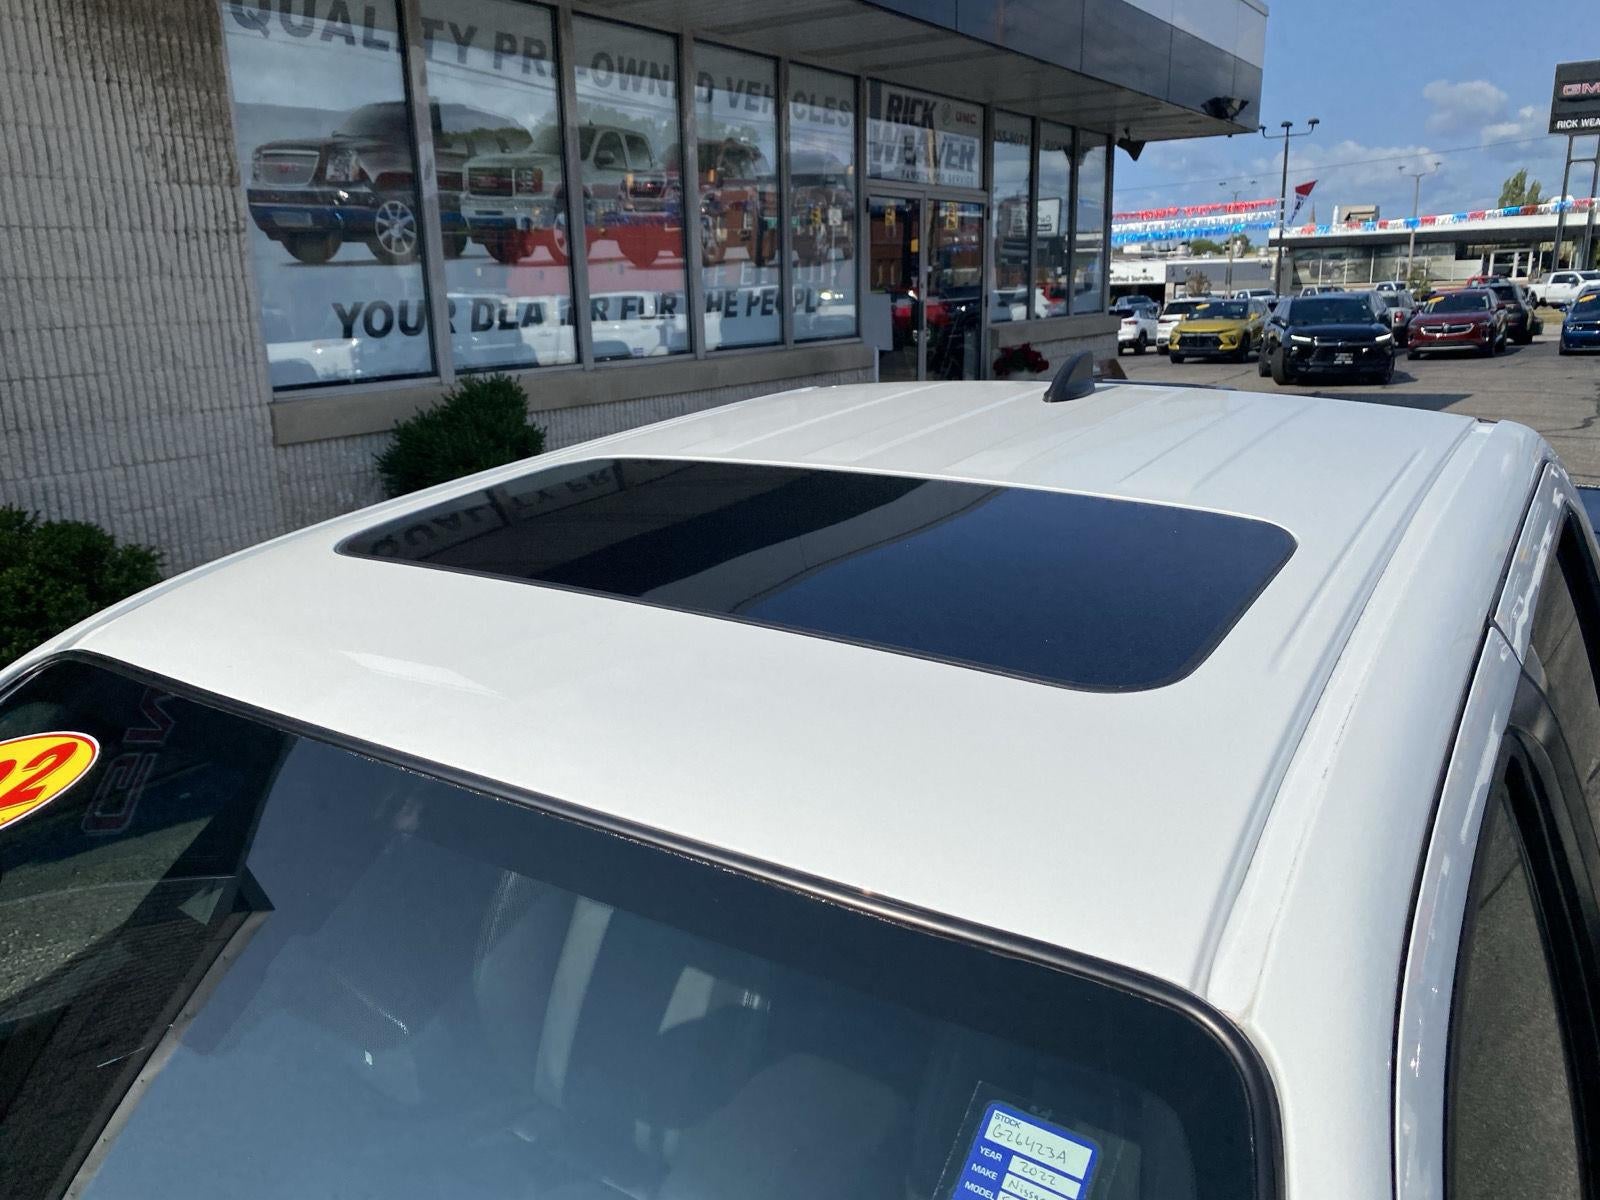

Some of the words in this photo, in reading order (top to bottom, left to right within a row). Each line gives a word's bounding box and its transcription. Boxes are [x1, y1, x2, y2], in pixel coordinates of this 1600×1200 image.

[230, 0, 477, 65] QUALTY
[493, 30, 714, 104] PR-OWND
[725, 76, 850, 128] VEHCLES
[886, 93, 937, 129] RICK
[1557, 119, 1579, 129] RICK
[704, 289, 738, 318] HE
[994, 1112, 1021, 1129] STOCK
[979, 1146, 1003, 1162] YEAR
[992, 1123, 1067, 1165] G26423A
[971, 1163, 998, 1181] MAKE
[1019, 1161, 1058, 1186] 2022
[964, 1181, 995, 1200] MODEL
[1008, 1180, 1045, 1200] Nissa
